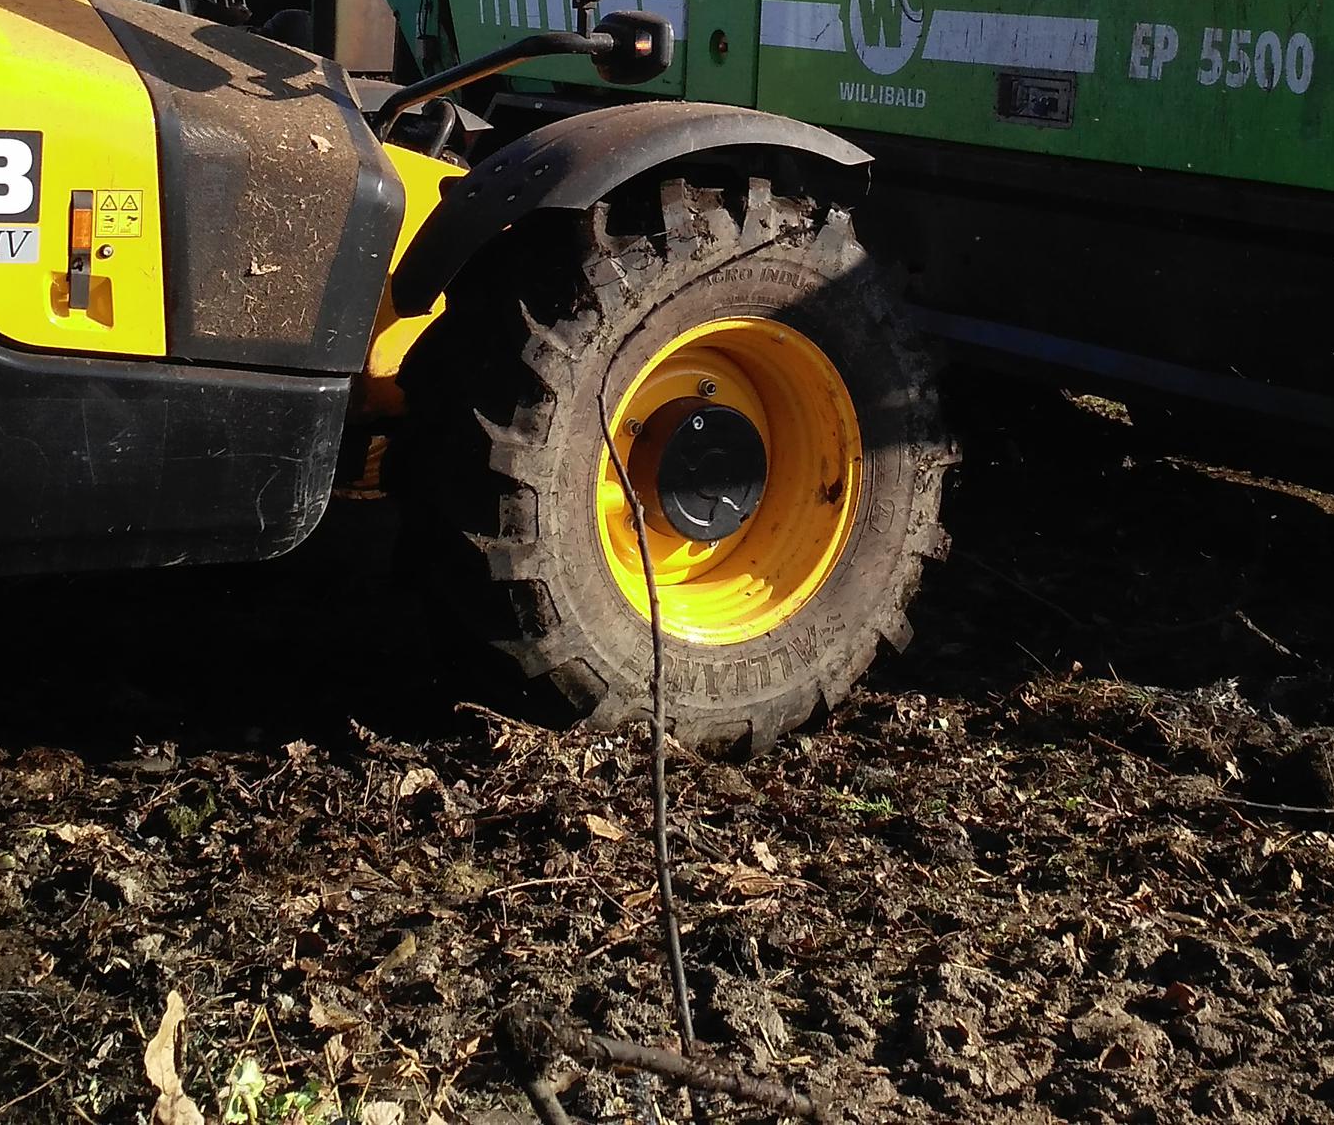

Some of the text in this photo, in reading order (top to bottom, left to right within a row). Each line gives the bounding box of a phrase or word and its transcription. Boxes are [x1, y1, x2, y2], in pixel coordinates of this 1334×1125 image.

[1128, 21, 1315, 95] EP 5500
[839, 81, 927, 109] WILLIBALD
[759, 267, 817, 294] INDUS
